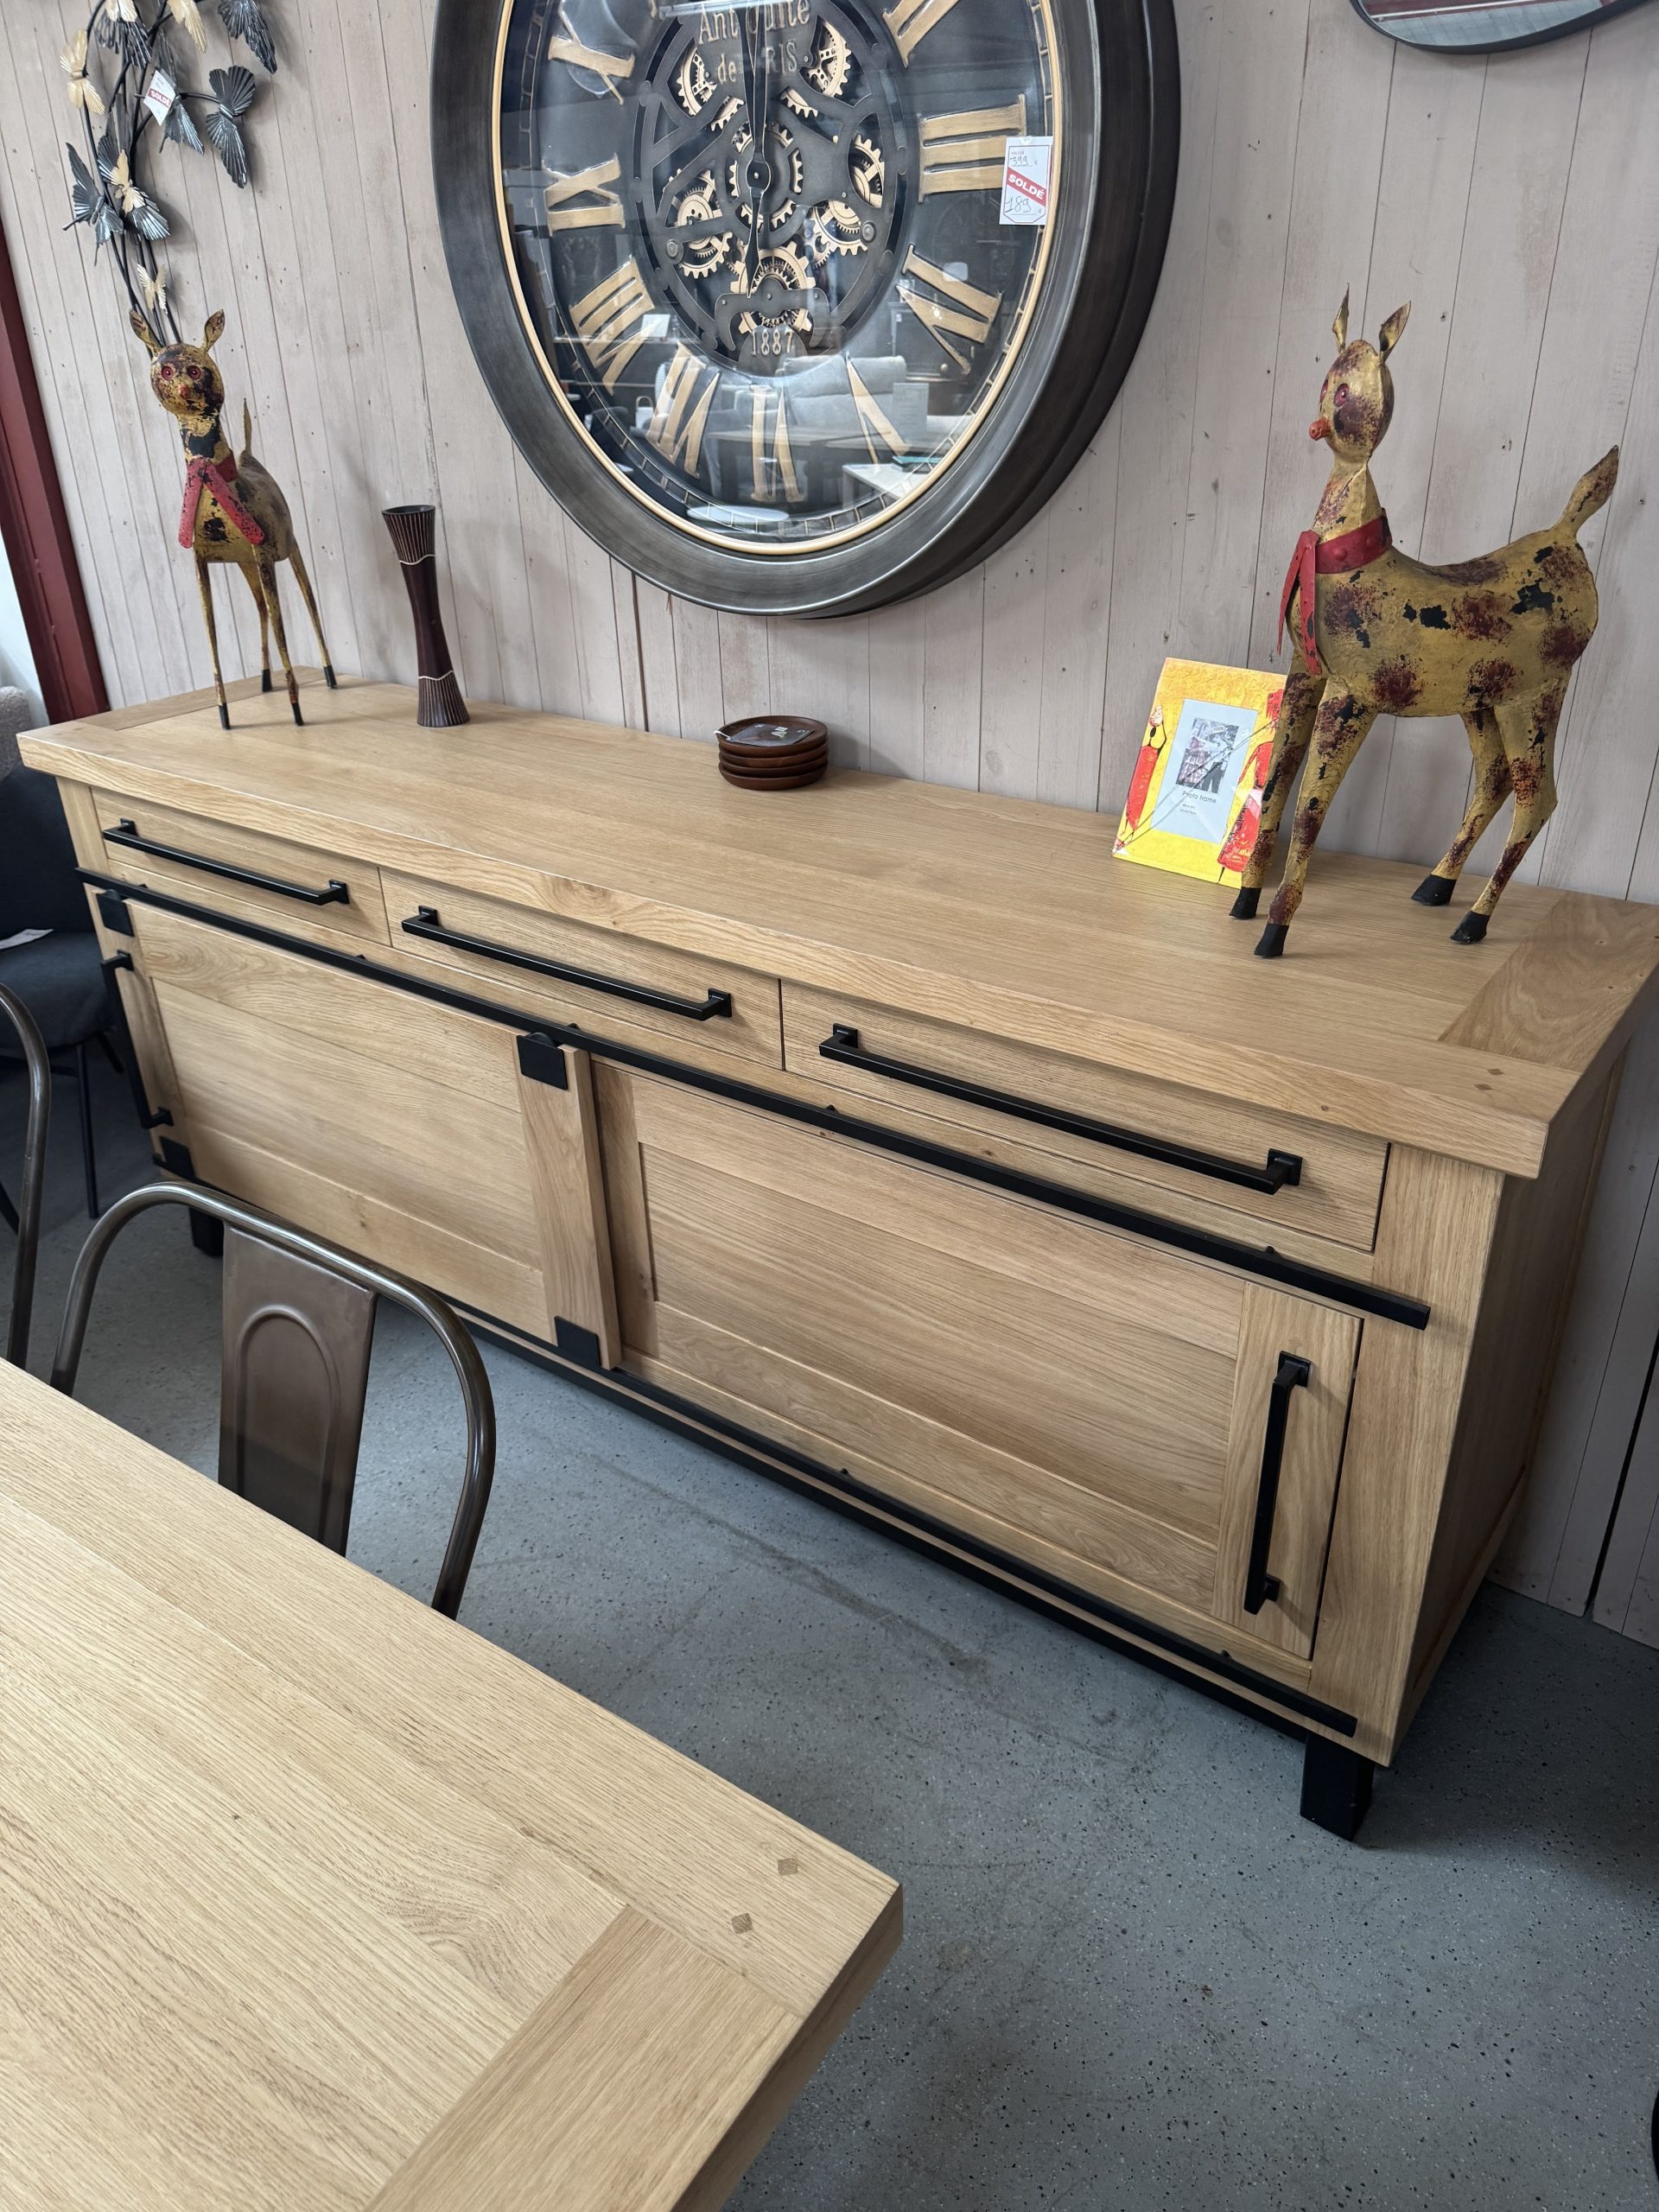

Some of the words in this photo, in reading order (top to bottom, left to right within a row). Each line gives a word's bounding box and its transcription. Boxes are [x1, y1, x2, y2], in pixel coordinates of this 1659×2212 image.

[717, 53, 737, 84] de
[1009, 156, 1028, 166] 399
[1007, 173, 1045, 200] SOLDÉ
[1004, 195, 1032, 213] 189
[752, 328, 794, 355] 1887
